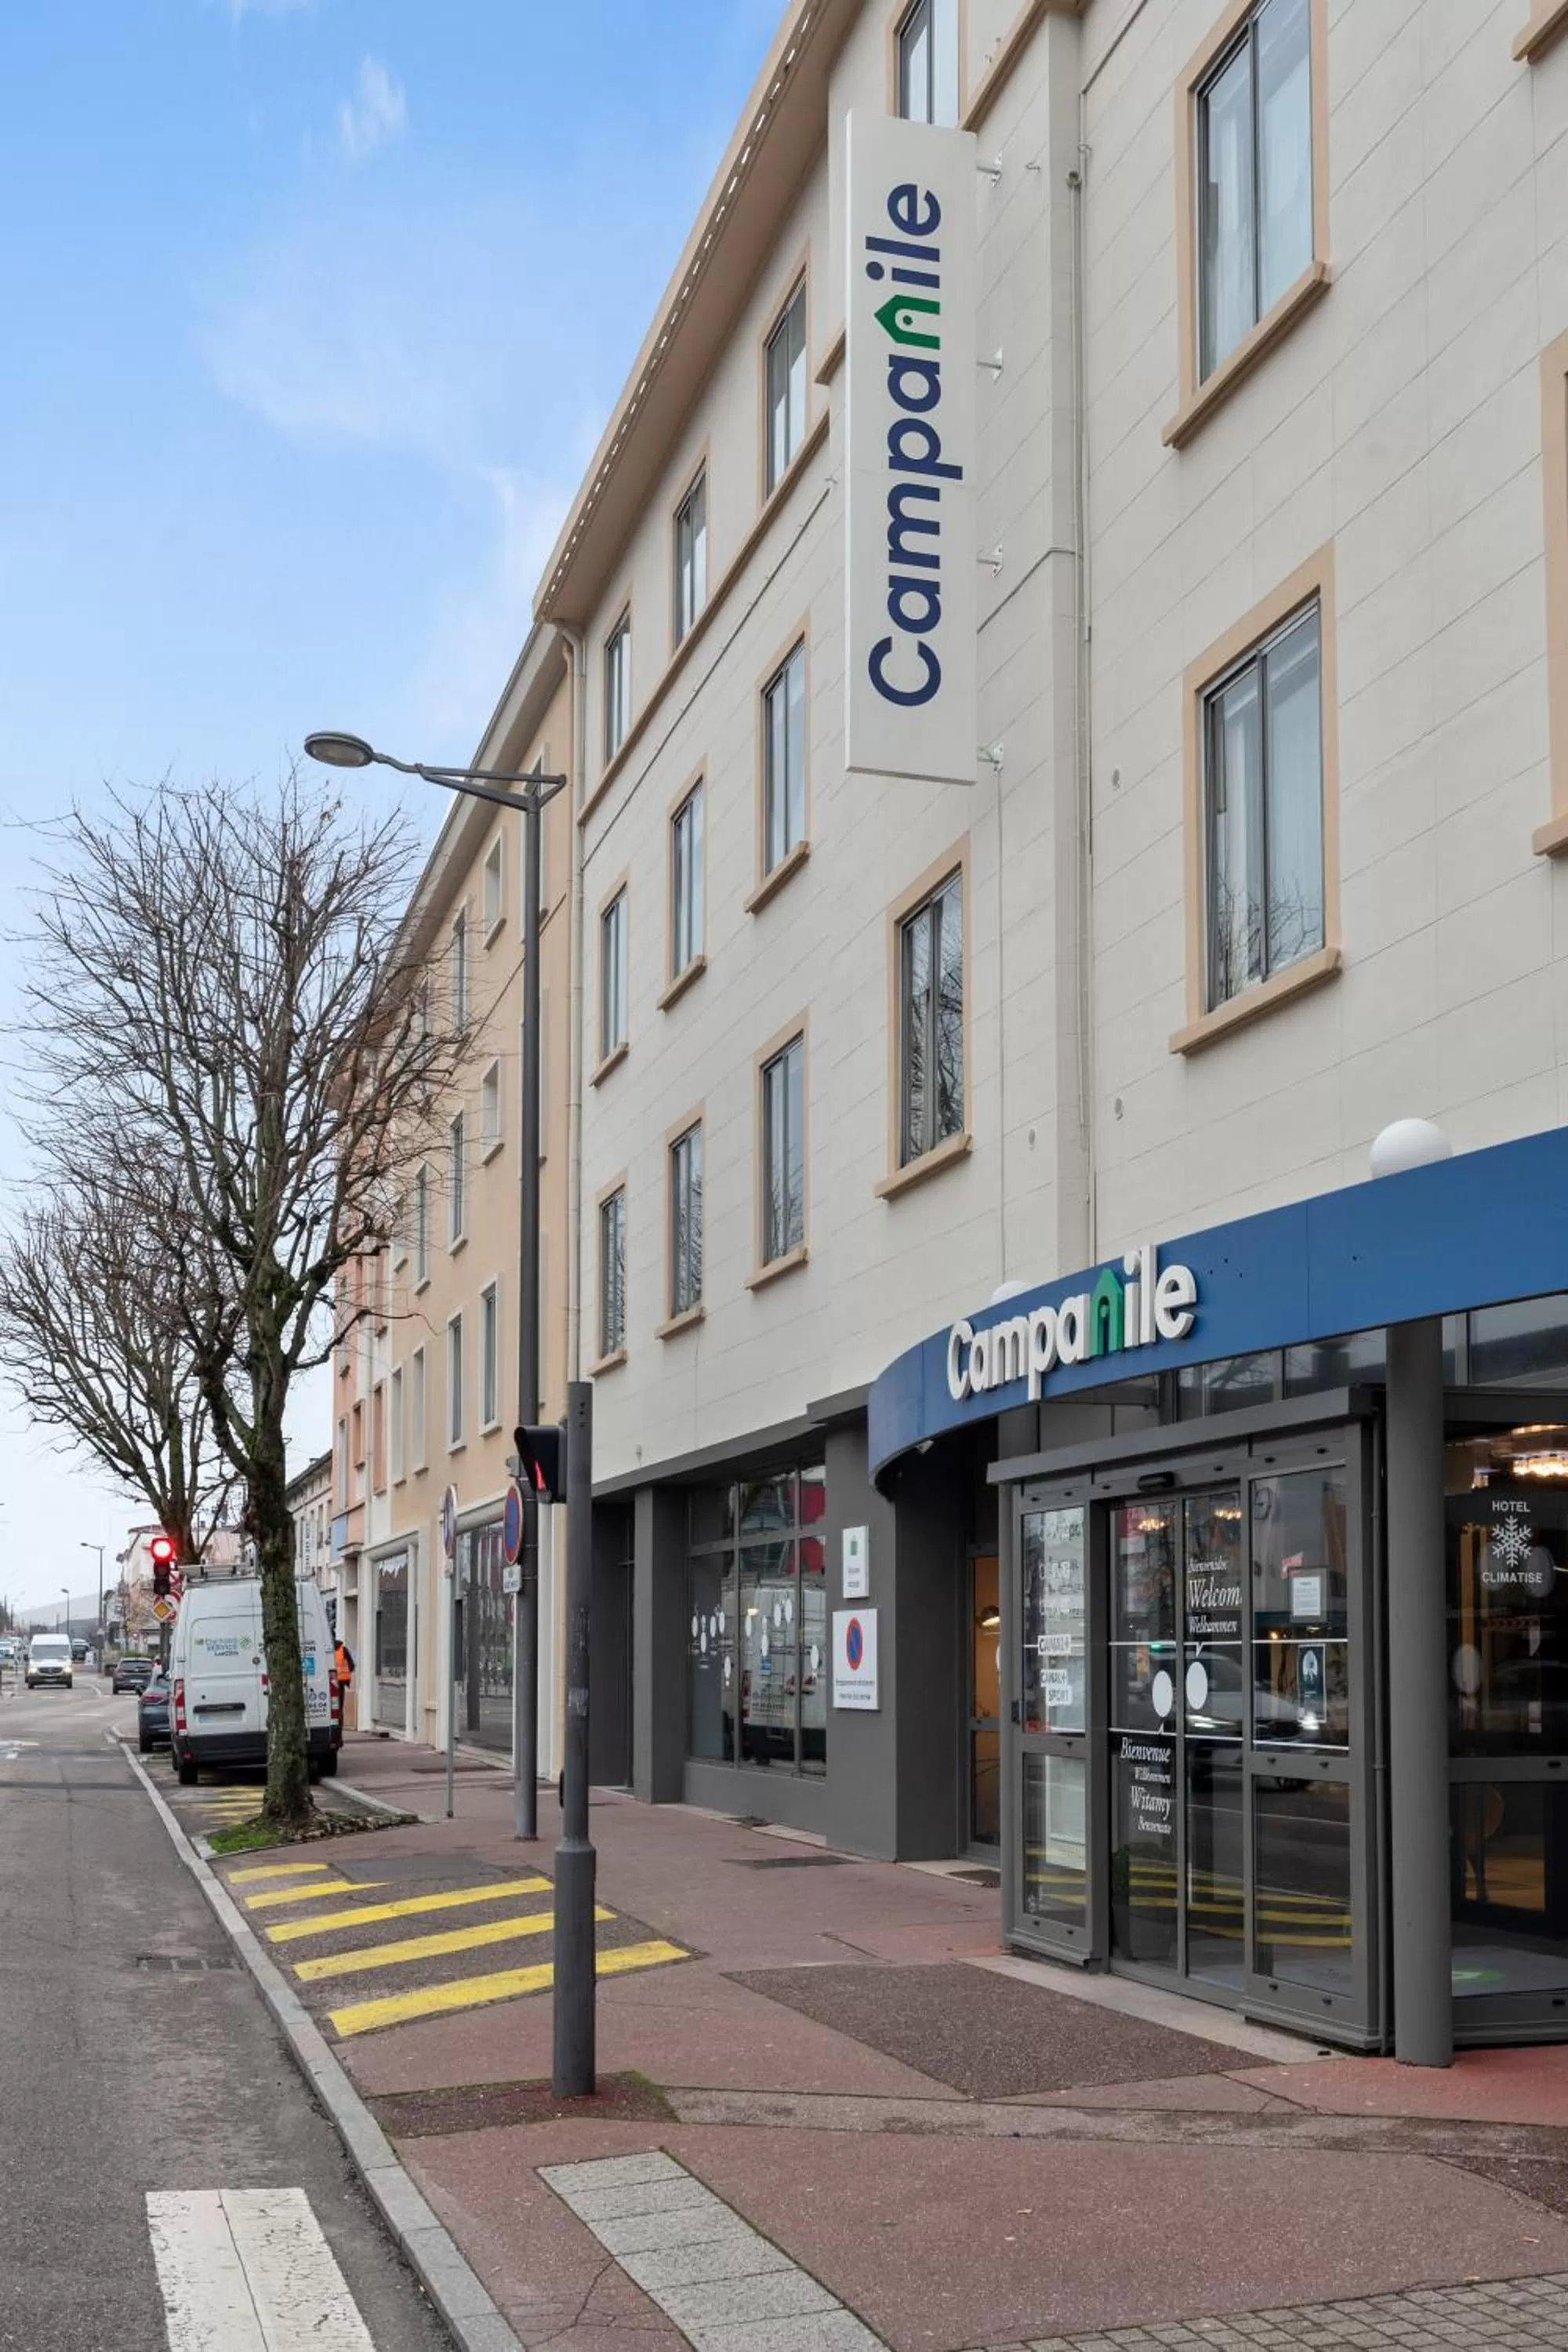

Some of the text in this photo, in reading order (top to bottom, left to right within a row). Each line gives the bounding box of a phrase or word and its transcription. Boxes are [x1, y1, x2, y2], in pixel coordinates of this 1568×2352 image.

[865, 183, 963, 706] Campanile
[947, 1244, 1197, 1401] Campanile
[1492, 1500, 1530, 1512] HOTEL
[1189, 1576, 1243, 1608] Welcom
[1483, 1571, 1543, 1584] CLIMATISE
[1120, 1737, 1171, 1763] Bienvenue
